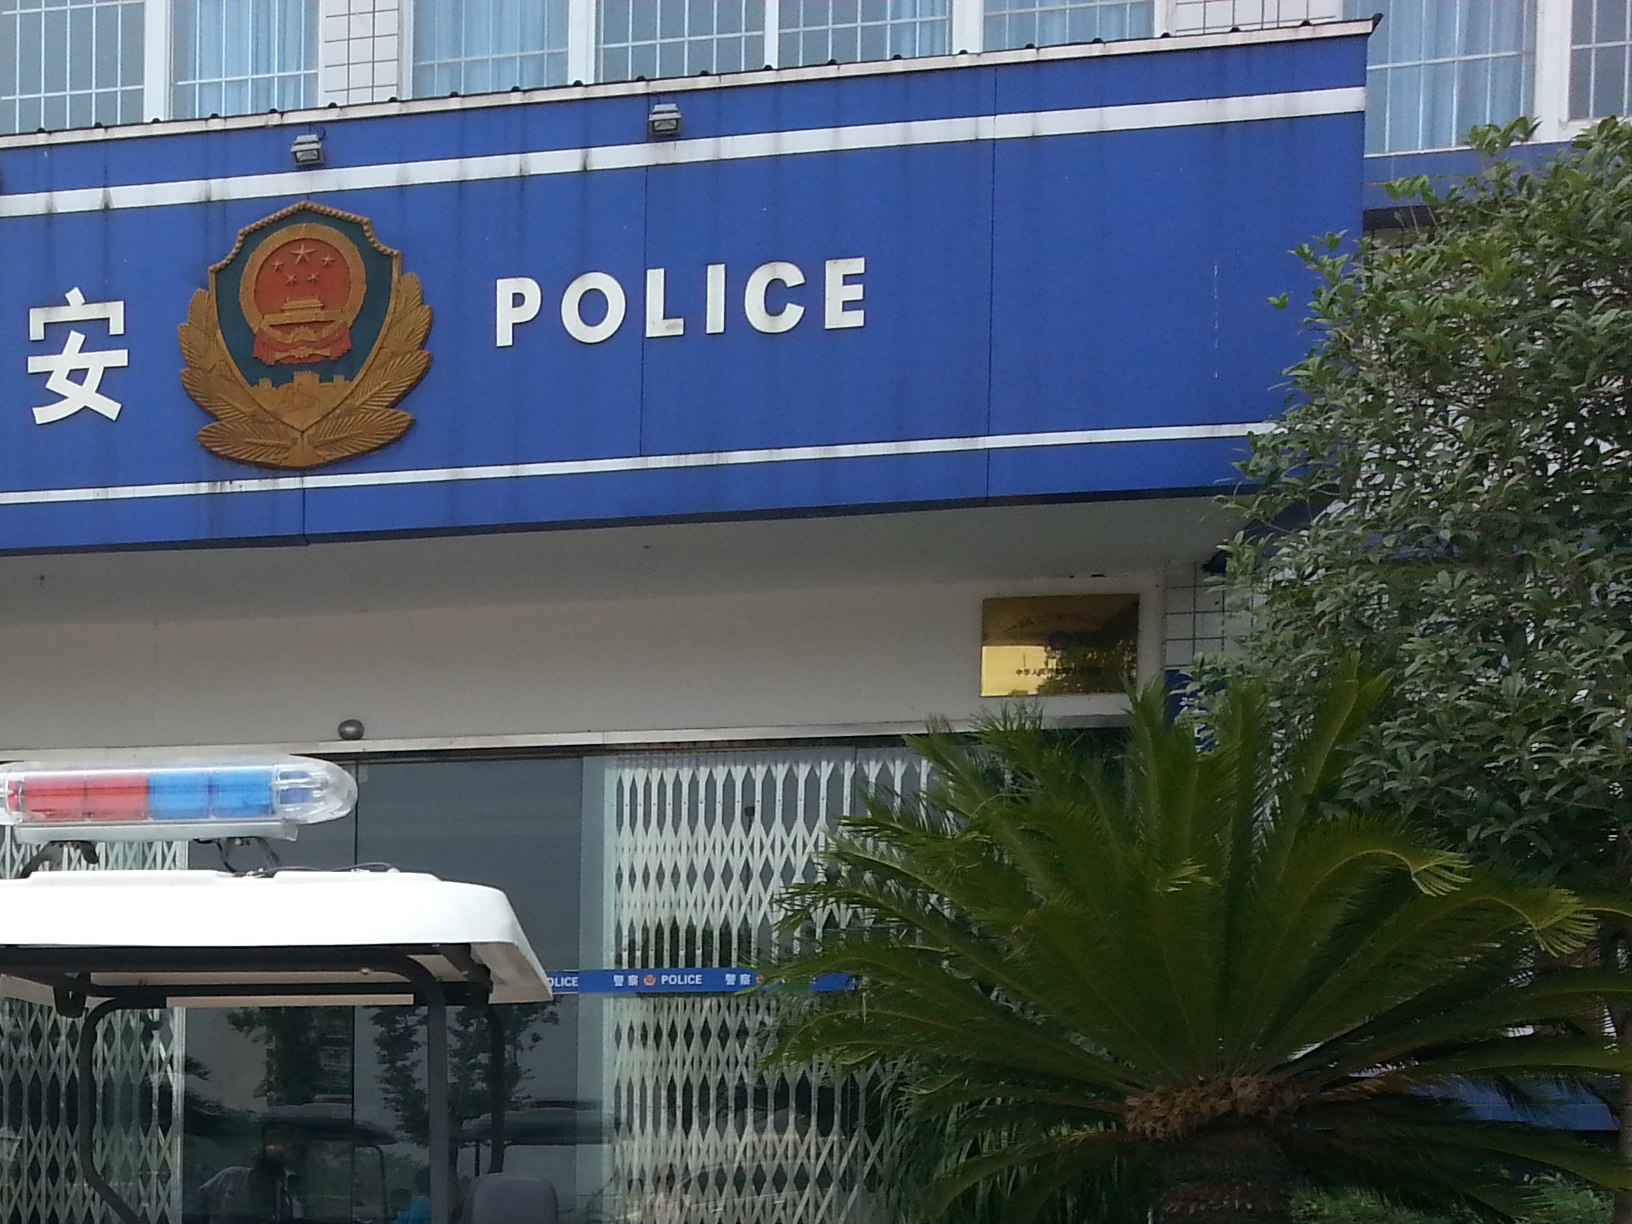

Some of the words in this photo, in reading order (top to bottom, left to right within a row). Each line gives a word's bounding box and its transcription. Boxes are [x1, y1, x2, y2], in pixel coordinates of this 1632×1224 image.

[495, 256, 866, 348] POLICE
[547, 976, 578, 987] OLICE
[613, 974, 639, 987] 警察
[661, 974, 703, 986] POLICE
[725, 973, 752, 986] 警察
